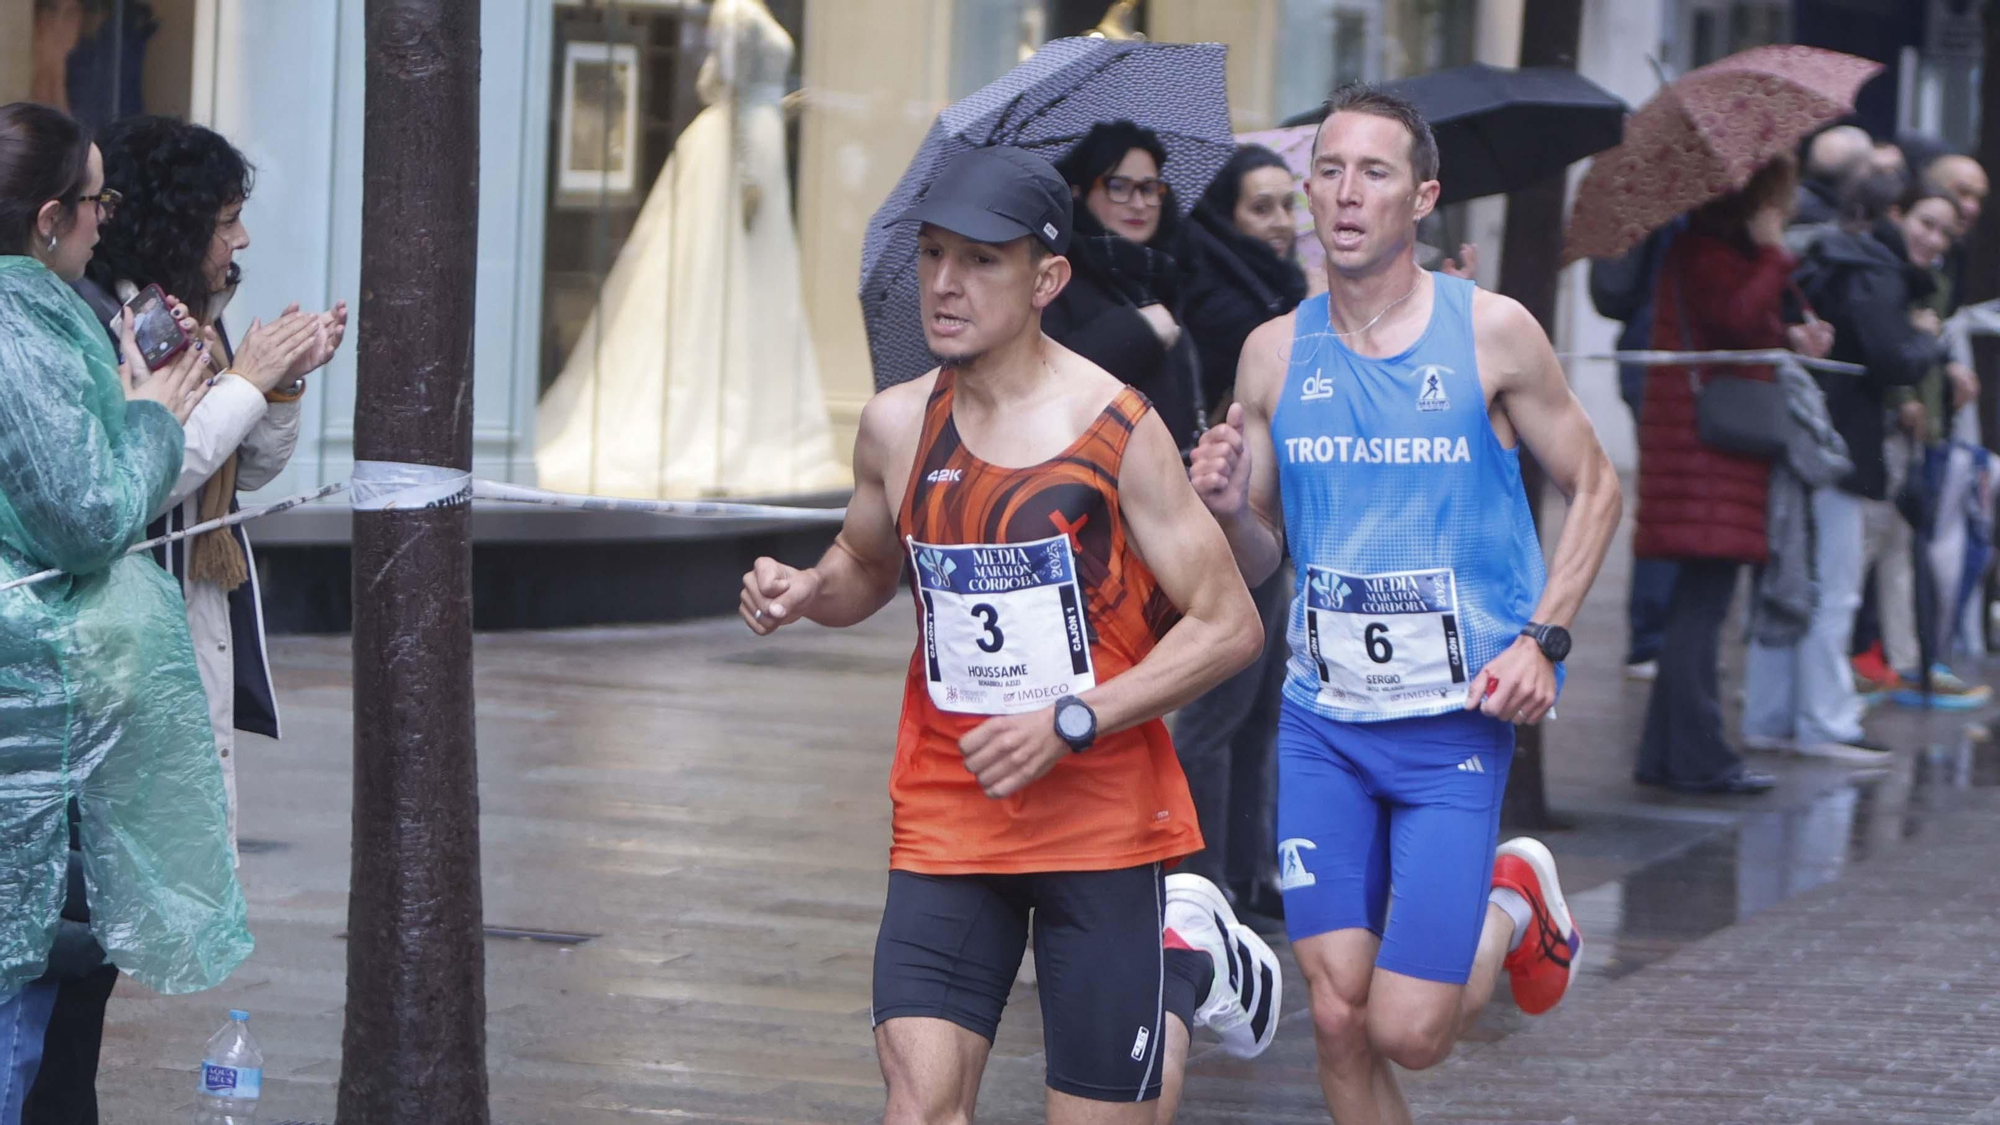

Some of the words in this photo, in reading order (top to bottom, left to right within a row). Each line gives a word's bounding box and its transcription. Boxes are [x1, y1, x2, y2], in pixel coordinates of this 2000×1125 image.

[1284, 435, 1472, 464] TROTASIERRA
[927, 469, 962, 482] 42K
[972, 548, 1031, 566] MEDIA
[1047, 543, 1063, 579] 2025
[974, 562, 1033, 578] MARATÓN
[968, 573, 1042, 591] CÓRDOBA
[1363, 576, 1419, 592] MEDIA
[970, 602, 1004, 653] 3
[1068, 615, 1082, 652] CAJÓN
[1364, 622, 1394, 664] 6
[967, 664, 1029, 678] HOUSSAME
[1366, 674, 1401, 685] SERGIO
[1017, 683, 1069, 701] IMDECO
